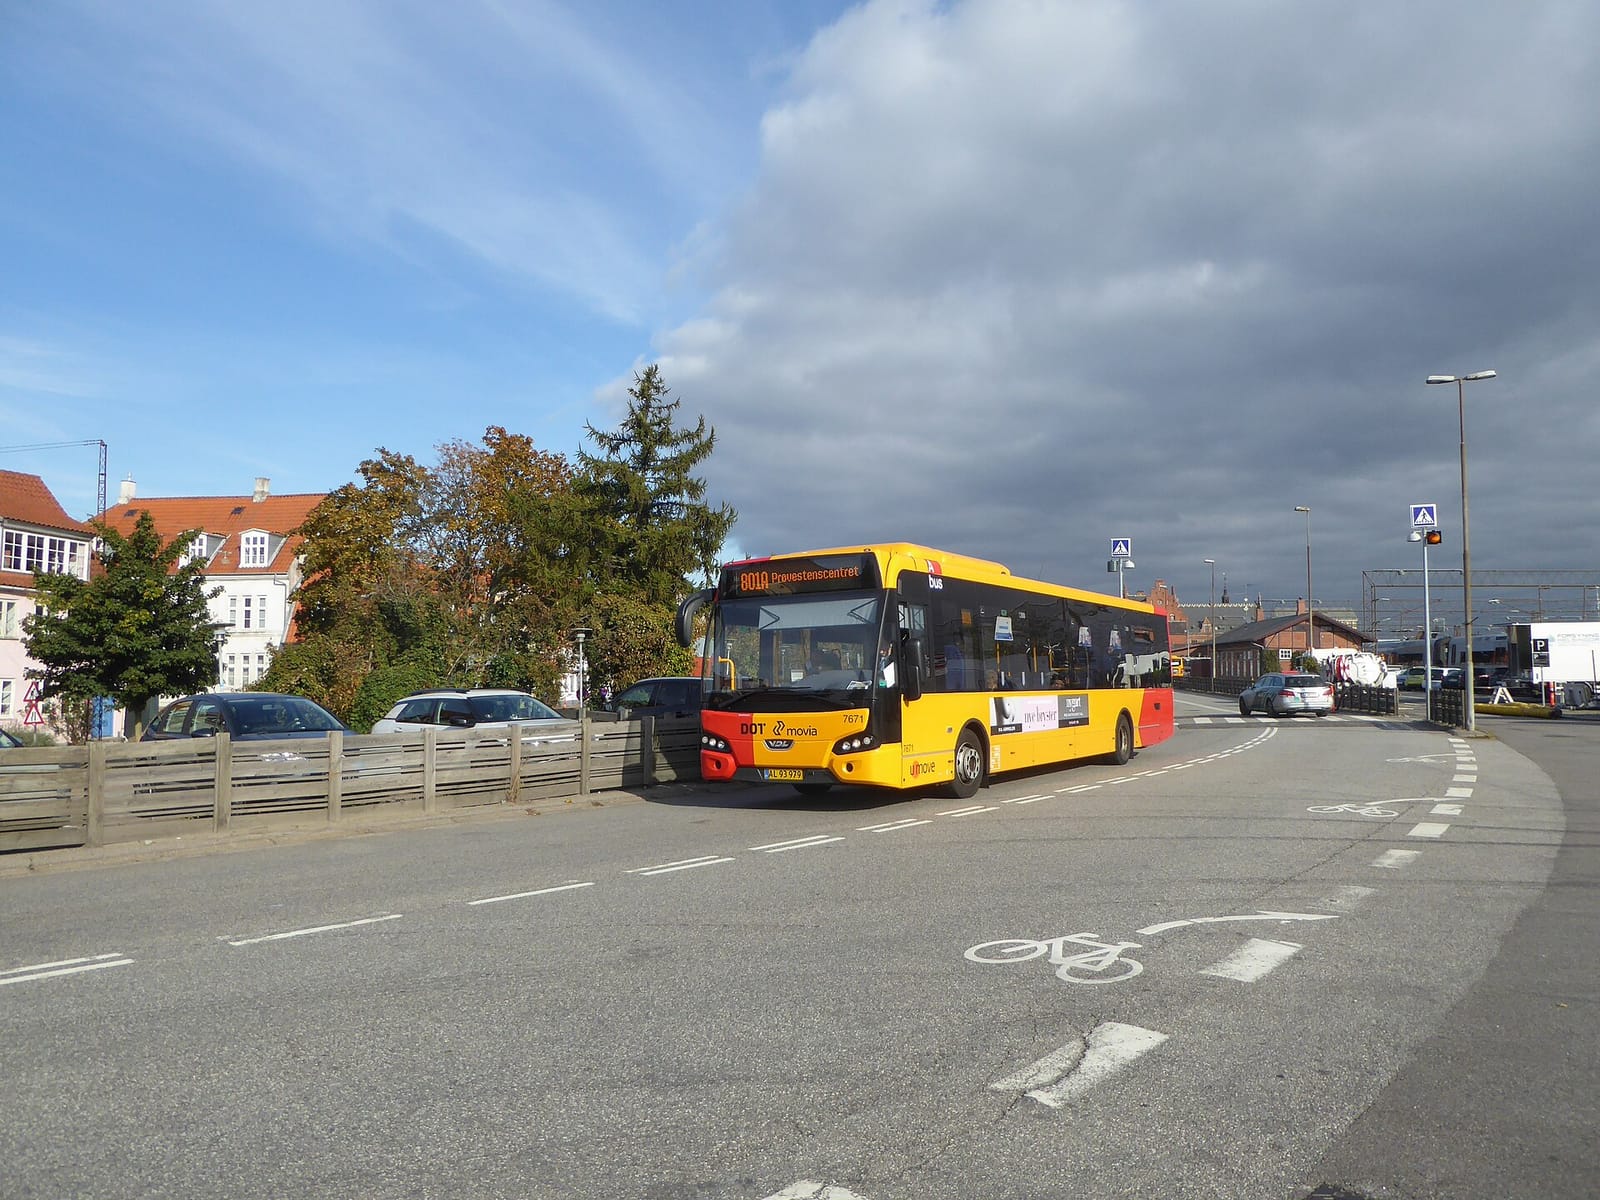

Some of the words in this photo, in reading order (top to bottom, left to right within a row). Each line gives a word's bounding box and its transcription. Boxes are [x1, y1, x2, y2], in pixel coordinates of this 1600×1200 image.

[740, 571, 769, 591] 801A
[928, 574, 943, 590] bus
[1537, 640, 1545, 651] P
[843, 714, 864, 724] 7671
[740, 723, 766, 735] DOT
[786, 725, 818, 736] movia
[769, 769, 778, 778] AL
[779, 769, 788, 778] 93
